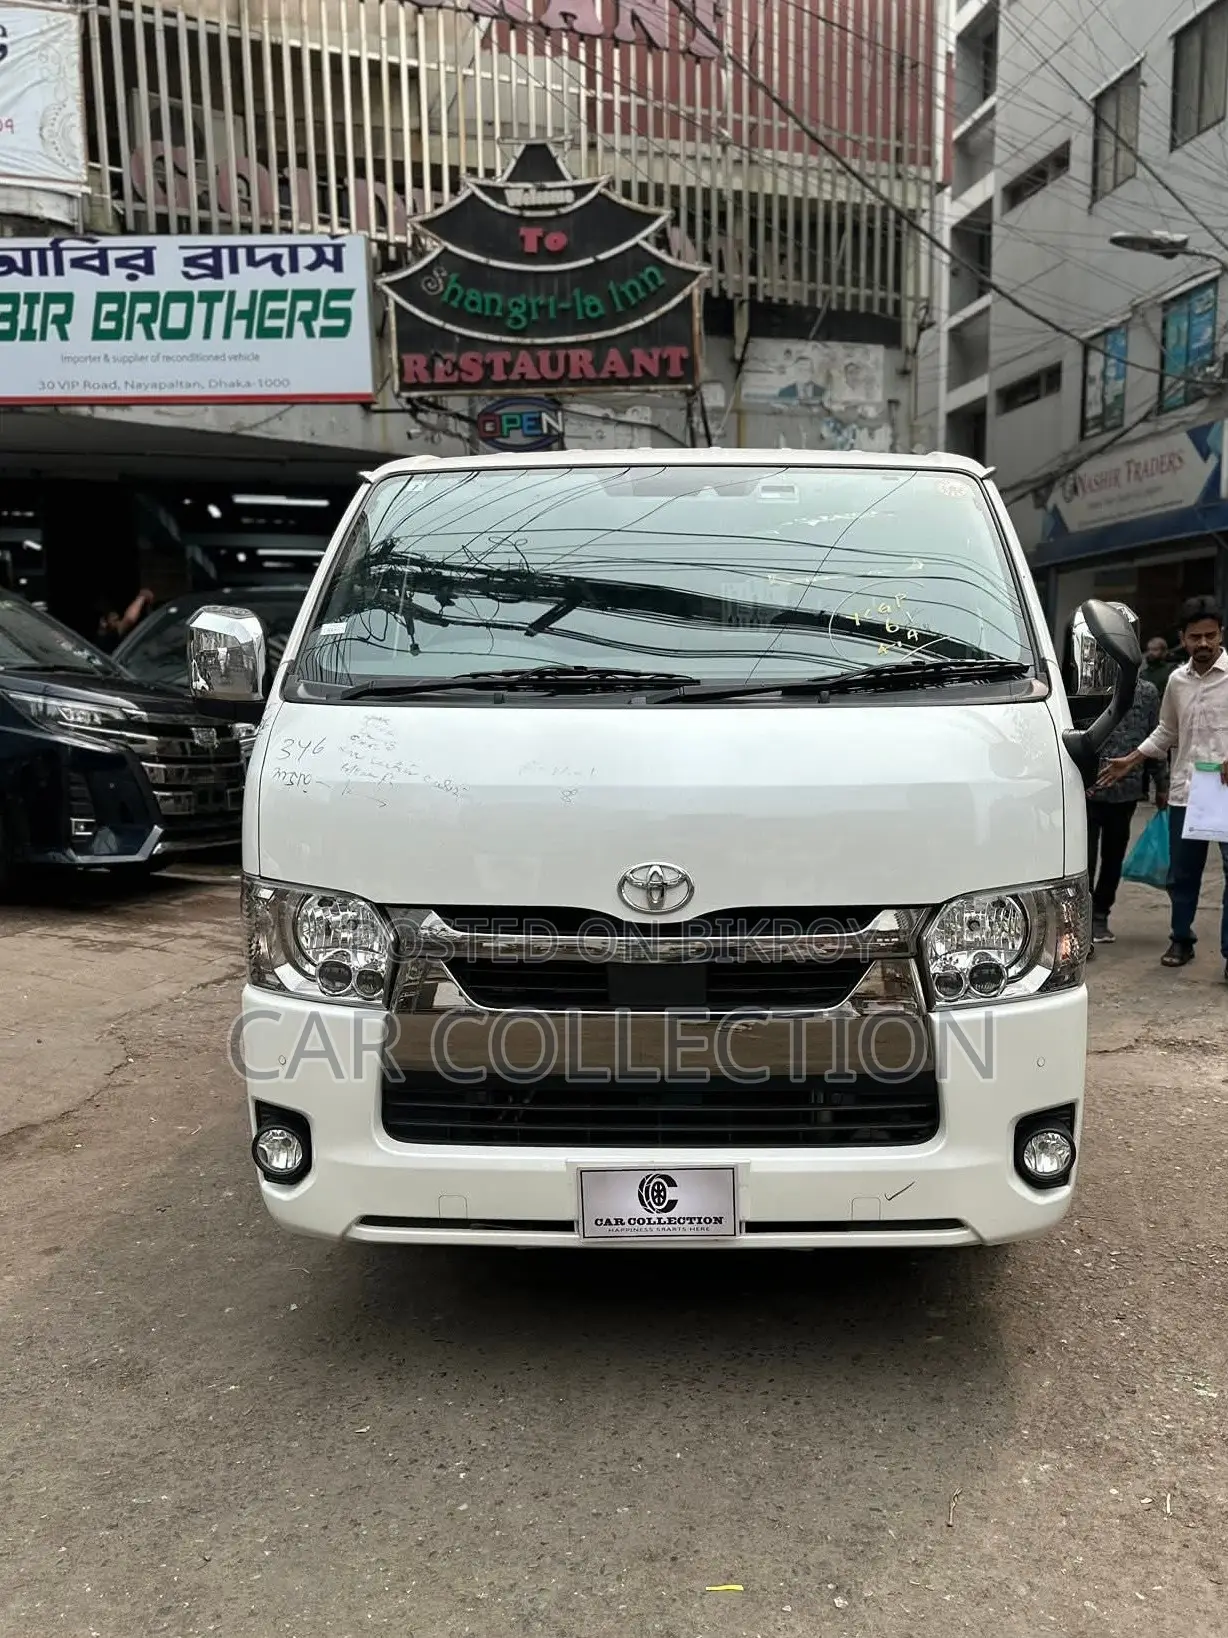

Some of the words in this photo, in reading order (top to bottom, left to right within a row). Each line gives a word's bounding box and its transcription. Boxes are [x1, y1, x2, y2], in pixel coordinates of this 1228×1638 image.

[518, 227, 569, 253] To
[421, 265, 606, 331] Shangri-la
[608, 264, 668, 312] Inn
[91, 288, 357, 341] BROTHERS
[61, 354, 101, 365] Importer
[104, 354, 110, 363] &
[112, 354, 149, 365] supplier
[151, 353, 160, 363] of
[162, 352, 226, 362] reconditioned
[228, 352, 260, 362] vehicle
[402, 346, 689, 385] RESTAURANT
[38, 380, 55, 391] 30
[57, 380, 79, 390] VIP
[209, 378, 290, 389] Dhaka-1000
[478, 410, 564, 439] OPEN
[594, 1217, 626, 1227] CAR
[627, 1216, 724, 1226] COLLECTION
